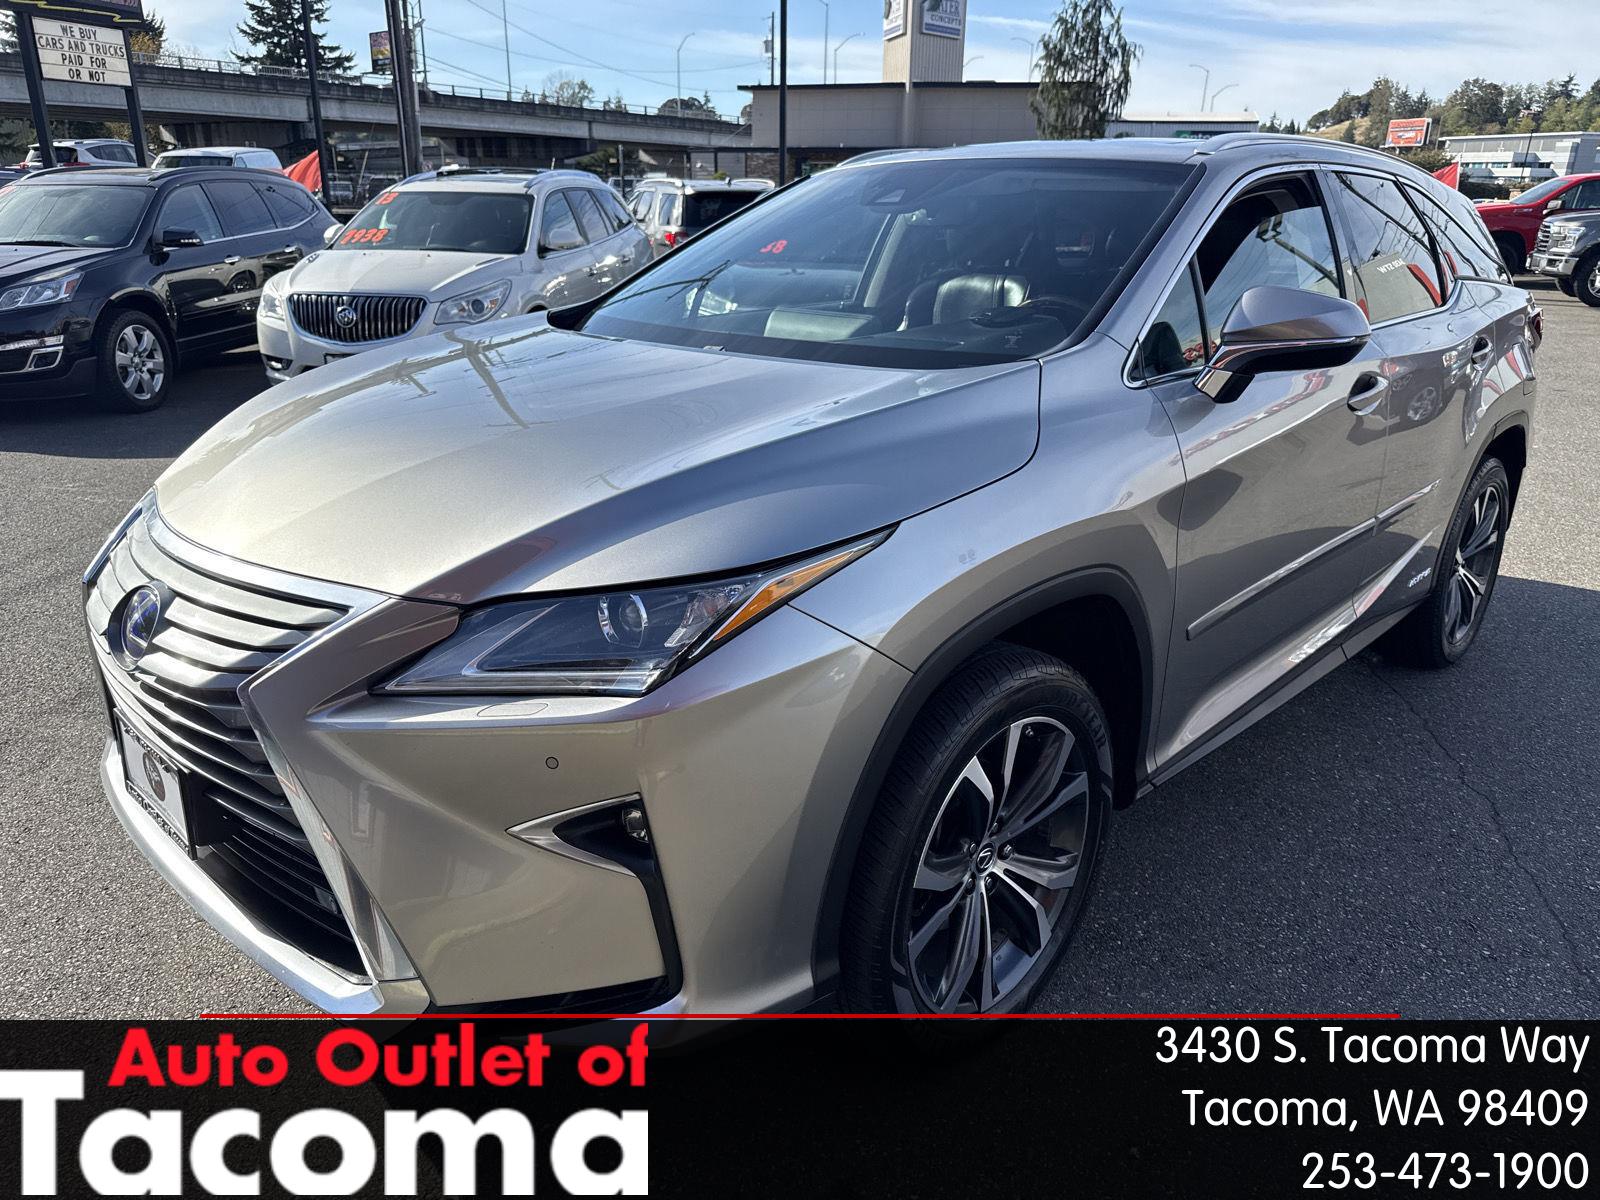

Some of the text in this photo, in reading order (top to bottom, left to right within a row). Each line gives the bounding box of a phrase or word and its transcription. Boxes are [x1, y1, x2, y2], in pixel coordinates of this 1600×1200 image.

[60, 24, 97, 41] WE BUY
[37, 36, 125, 58] CARS AND TRUCKS
[61, 53, 107, 69] PAID FOR
[68, 69, 106, 82] OR NOT
